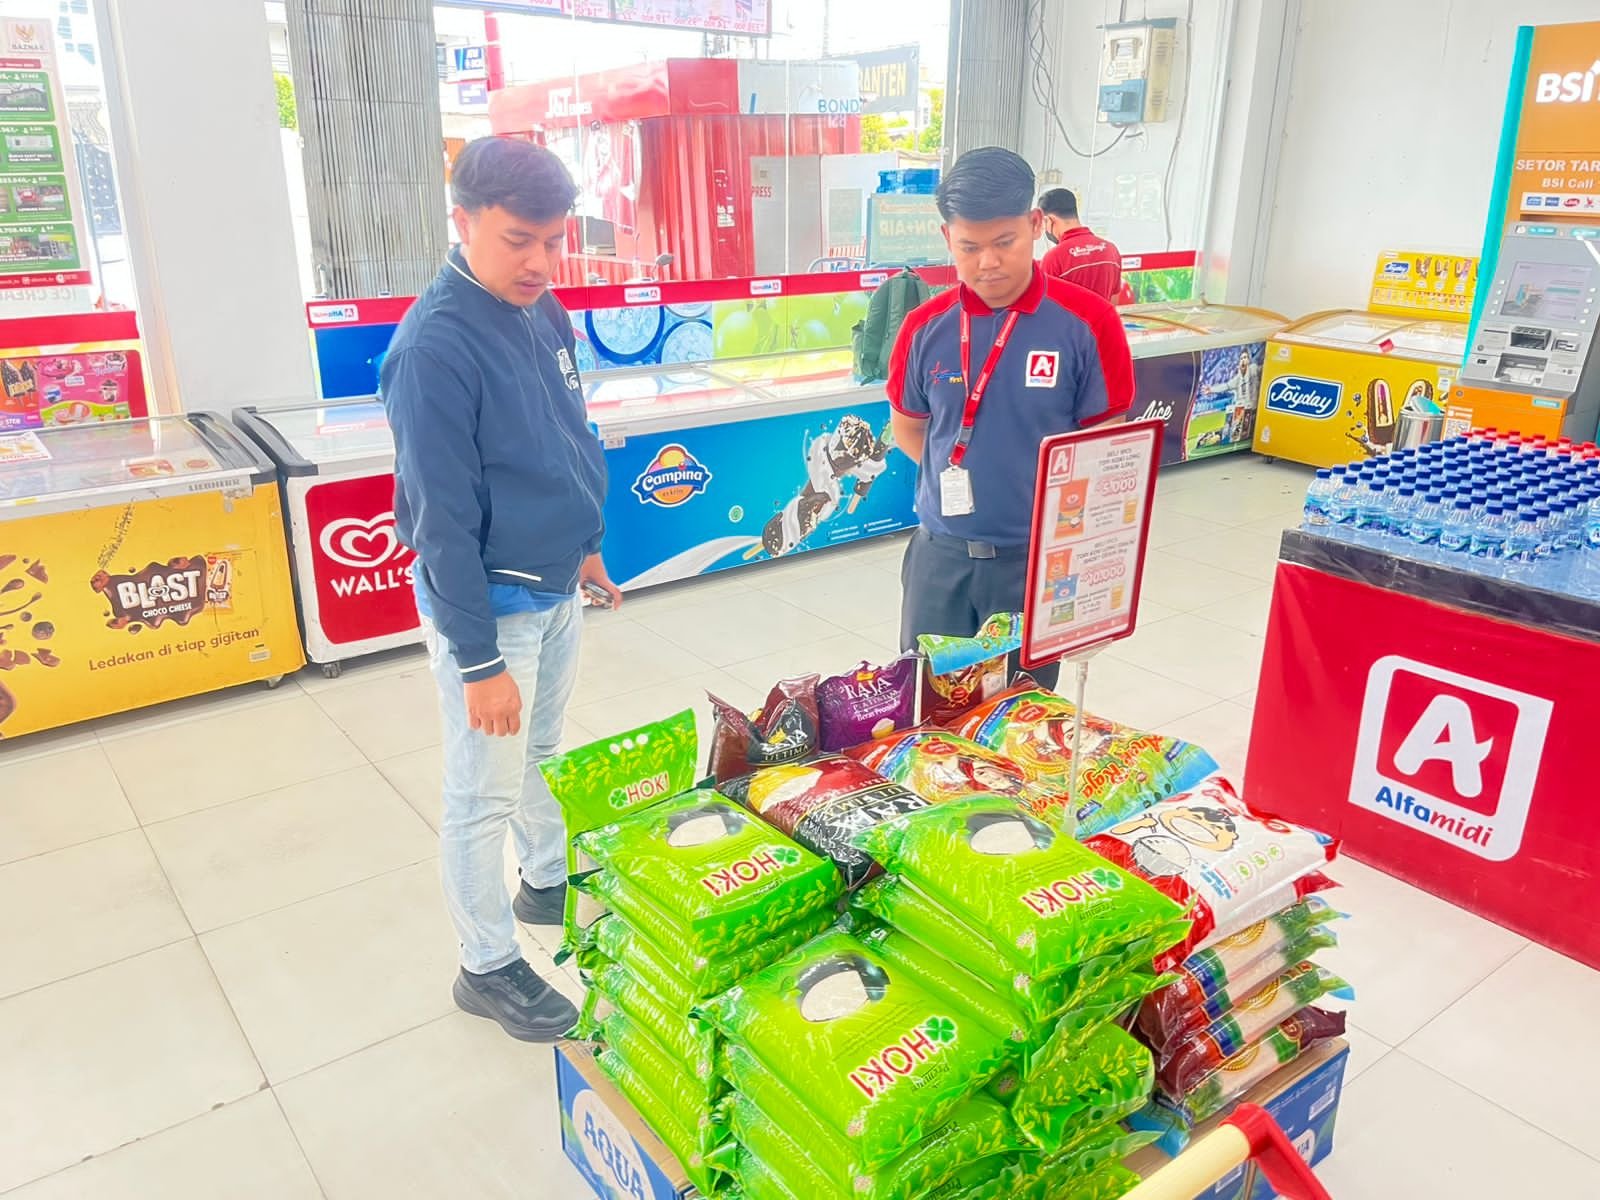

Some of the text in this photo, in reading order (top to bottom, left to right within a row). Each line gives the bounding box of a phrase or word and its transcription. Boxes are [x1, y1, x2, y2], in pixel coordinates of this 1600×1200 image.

[1536, 71, 1594, 103] BSI
[818, 98, 860, 113] BOND
[1516, 159, 1566, 172] SETOR
[1542, 177, 1594, 189] BSI Call
[642, 470, 703, 491] Campina
[117, 570, 201, 609] BLAST
[330, 566, 416, 598] WALL'S
[142, 602, 192, 618] CHOCO CHEESE
[88, 628, 259, 671] Ledakan di tiap gigitan
[844, 677, 893, 700] RAJA
[764, 743, 809, 761] ULTIMA
[626, 771, 670, 803] HOKI
[1082, 763, 1122, 799] Raja
[1375, 785, 1494, 847] Alfamidi
[702, 852, 781, 896] HOKI
[1021, 870, 1105, 918] HOKI
[848, 1024, 942, 1099] HOKI
[584, 1110, 645, 1200] AQUA
